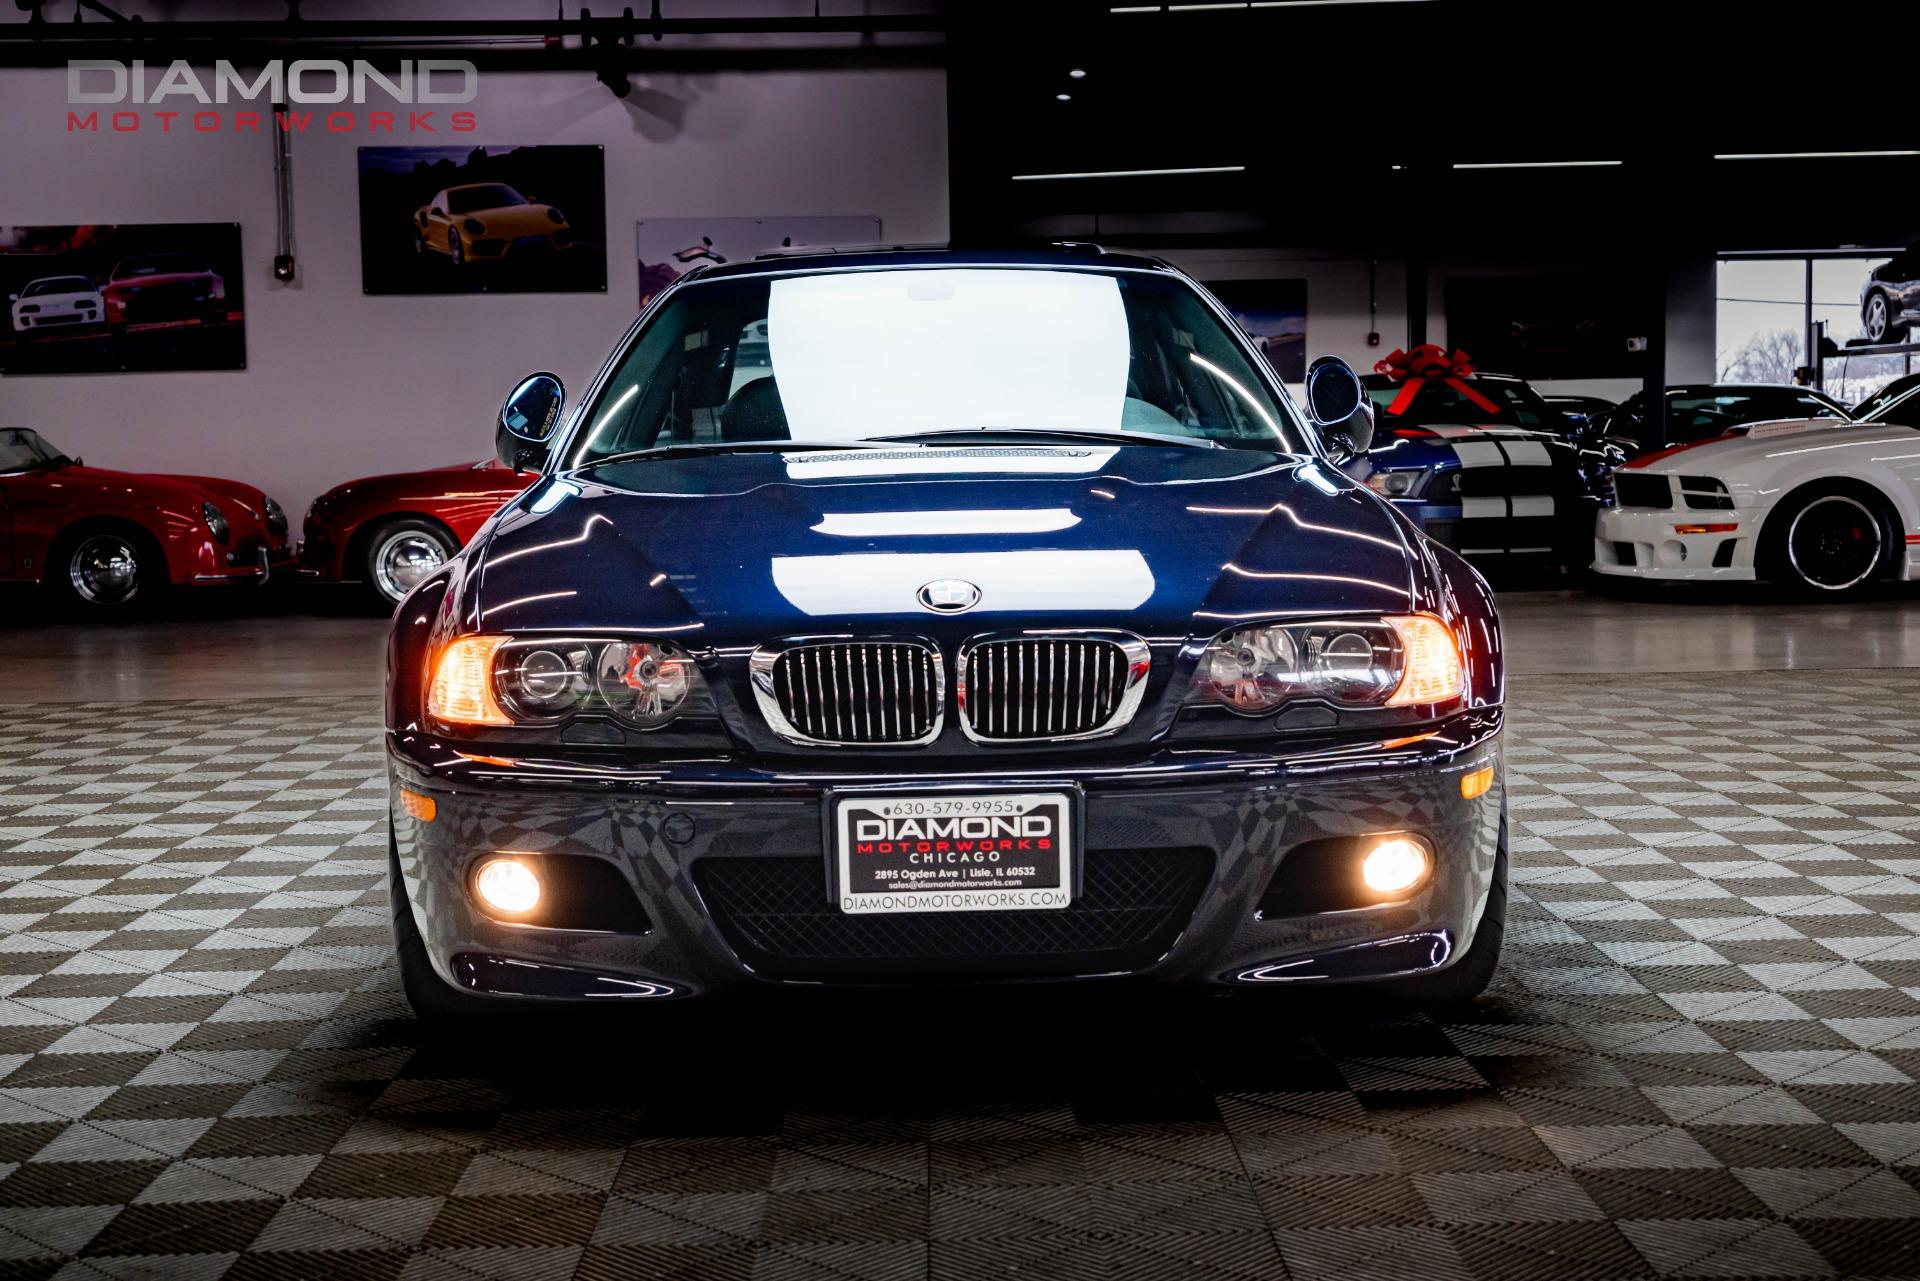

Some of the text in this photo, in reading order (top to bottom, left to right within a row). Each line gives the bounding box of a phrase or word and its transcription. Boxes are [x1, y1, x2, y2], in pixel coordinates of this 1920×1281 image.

[856, 816, 1052, 841] DIAMOND
[857, 840, 1052, 853] MOTORWORKS
[909, 851, 1001, 864] CHICAGO
[874, 870, 899, 880] 2895
[901, 869, 935, 881] Ogden
[938, 868, 959, 878] Ave
[996, 867, 1005, 877] IL
[1006, 867, 1036, 877] 60532
[888, 879, 1023, 890] sales@diamondmotorworks.com
[843, 892, 1068, 911] DIAMONDMOTORWORKS.COM
